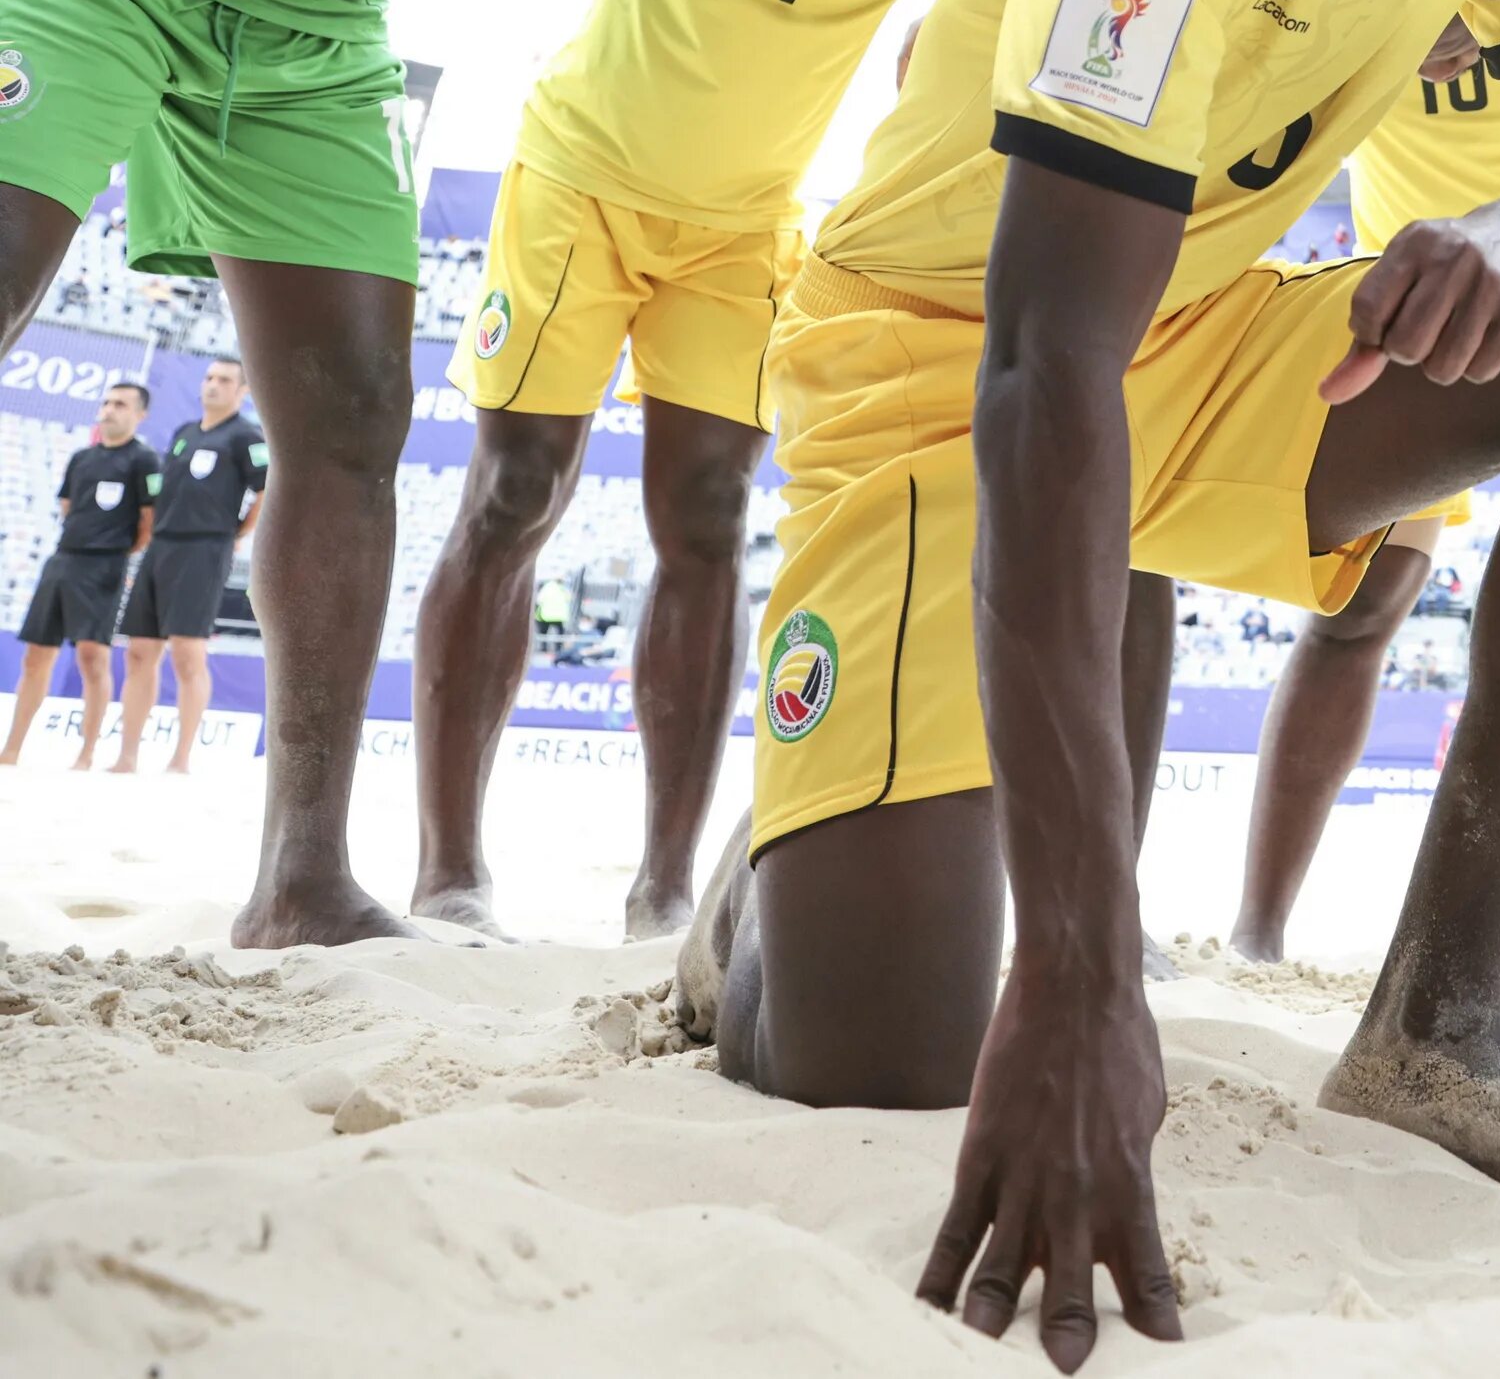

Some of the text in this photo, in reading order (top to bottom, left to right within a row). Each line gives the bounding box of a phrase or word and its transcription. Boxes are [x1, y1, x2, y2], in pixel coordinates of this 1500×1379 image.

[517, 680, 610, 712] BEACH
[816, 697, 825, 710] DE
[515, 739, 641, 767] #REACH
